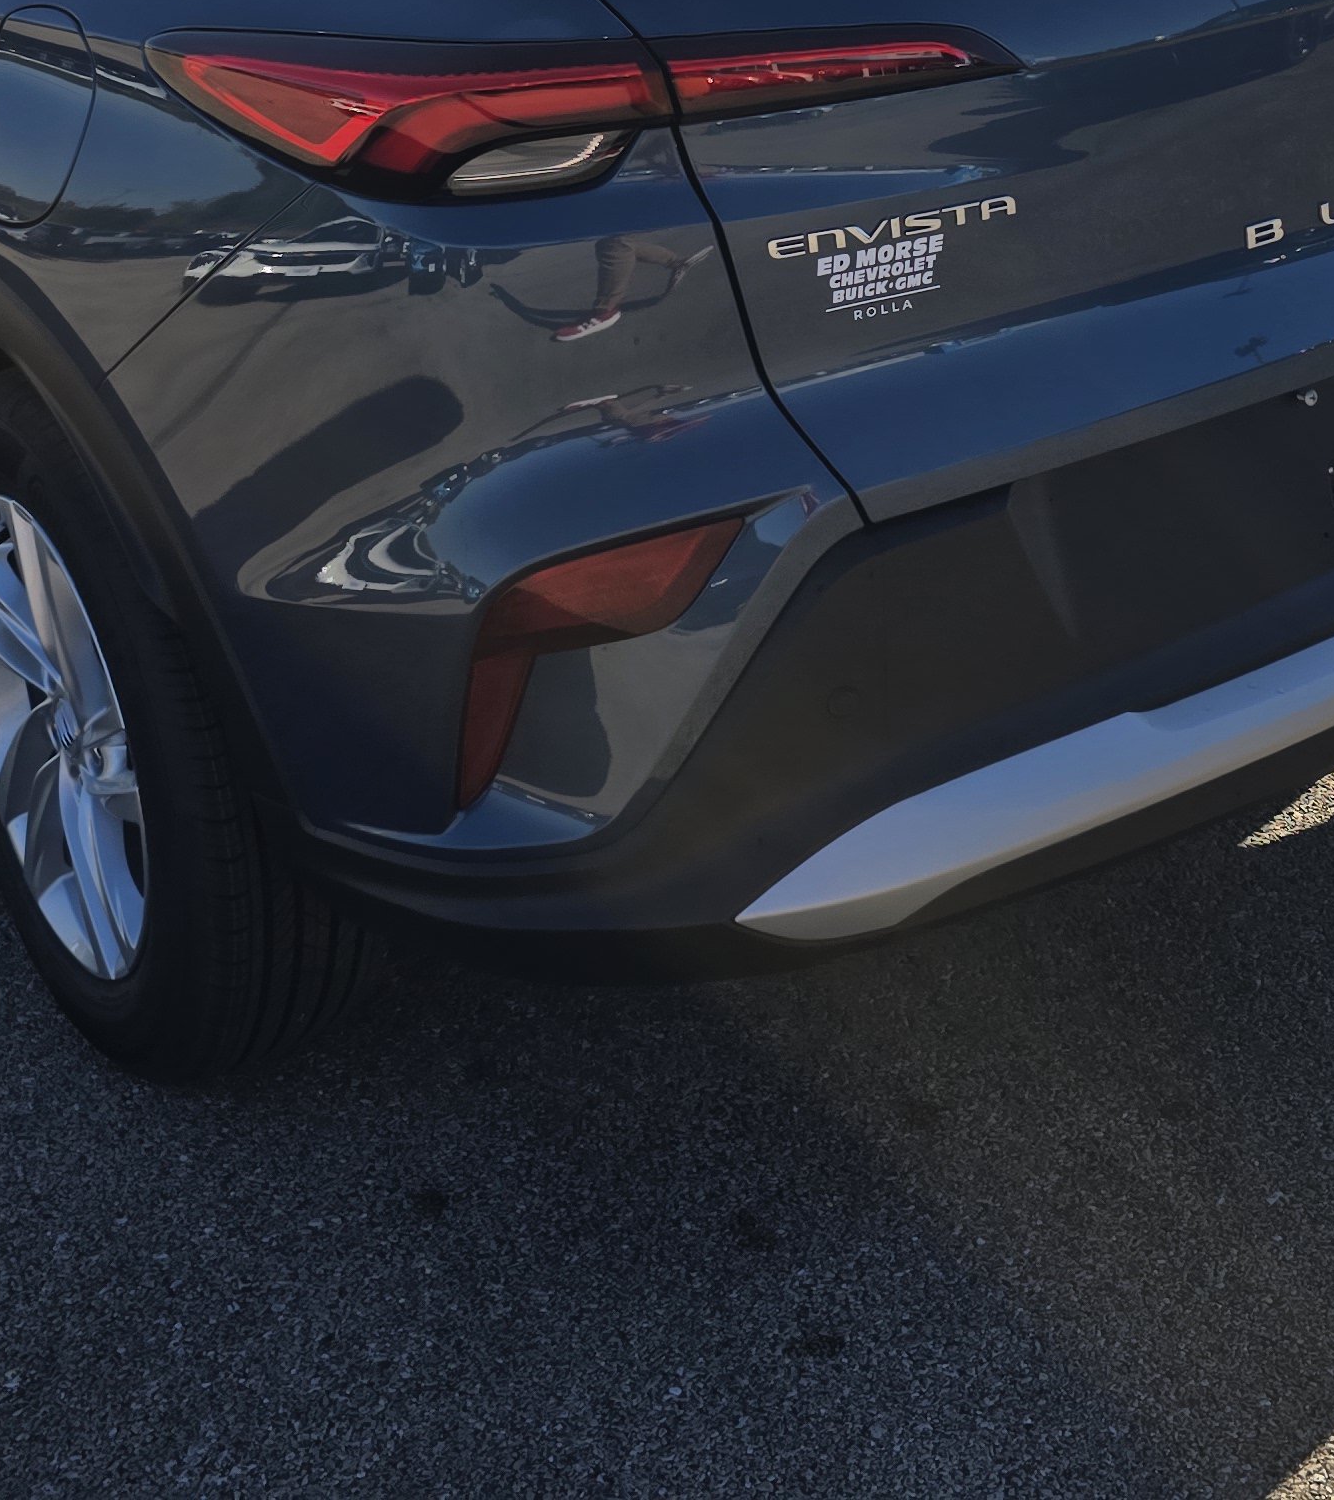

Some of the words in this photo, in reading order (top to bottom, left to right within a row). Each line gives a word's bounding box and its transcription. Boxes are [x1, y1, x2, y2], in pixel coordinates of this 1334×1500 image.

[768, 196, 1017, 259] ENVISTA
[817, 255, 851, 276] ED
[856, 234, 944, 267] MORSE
[829, 254, 937, 289] CHEVROLET
[854, 300, 913, 321] ROLLA
